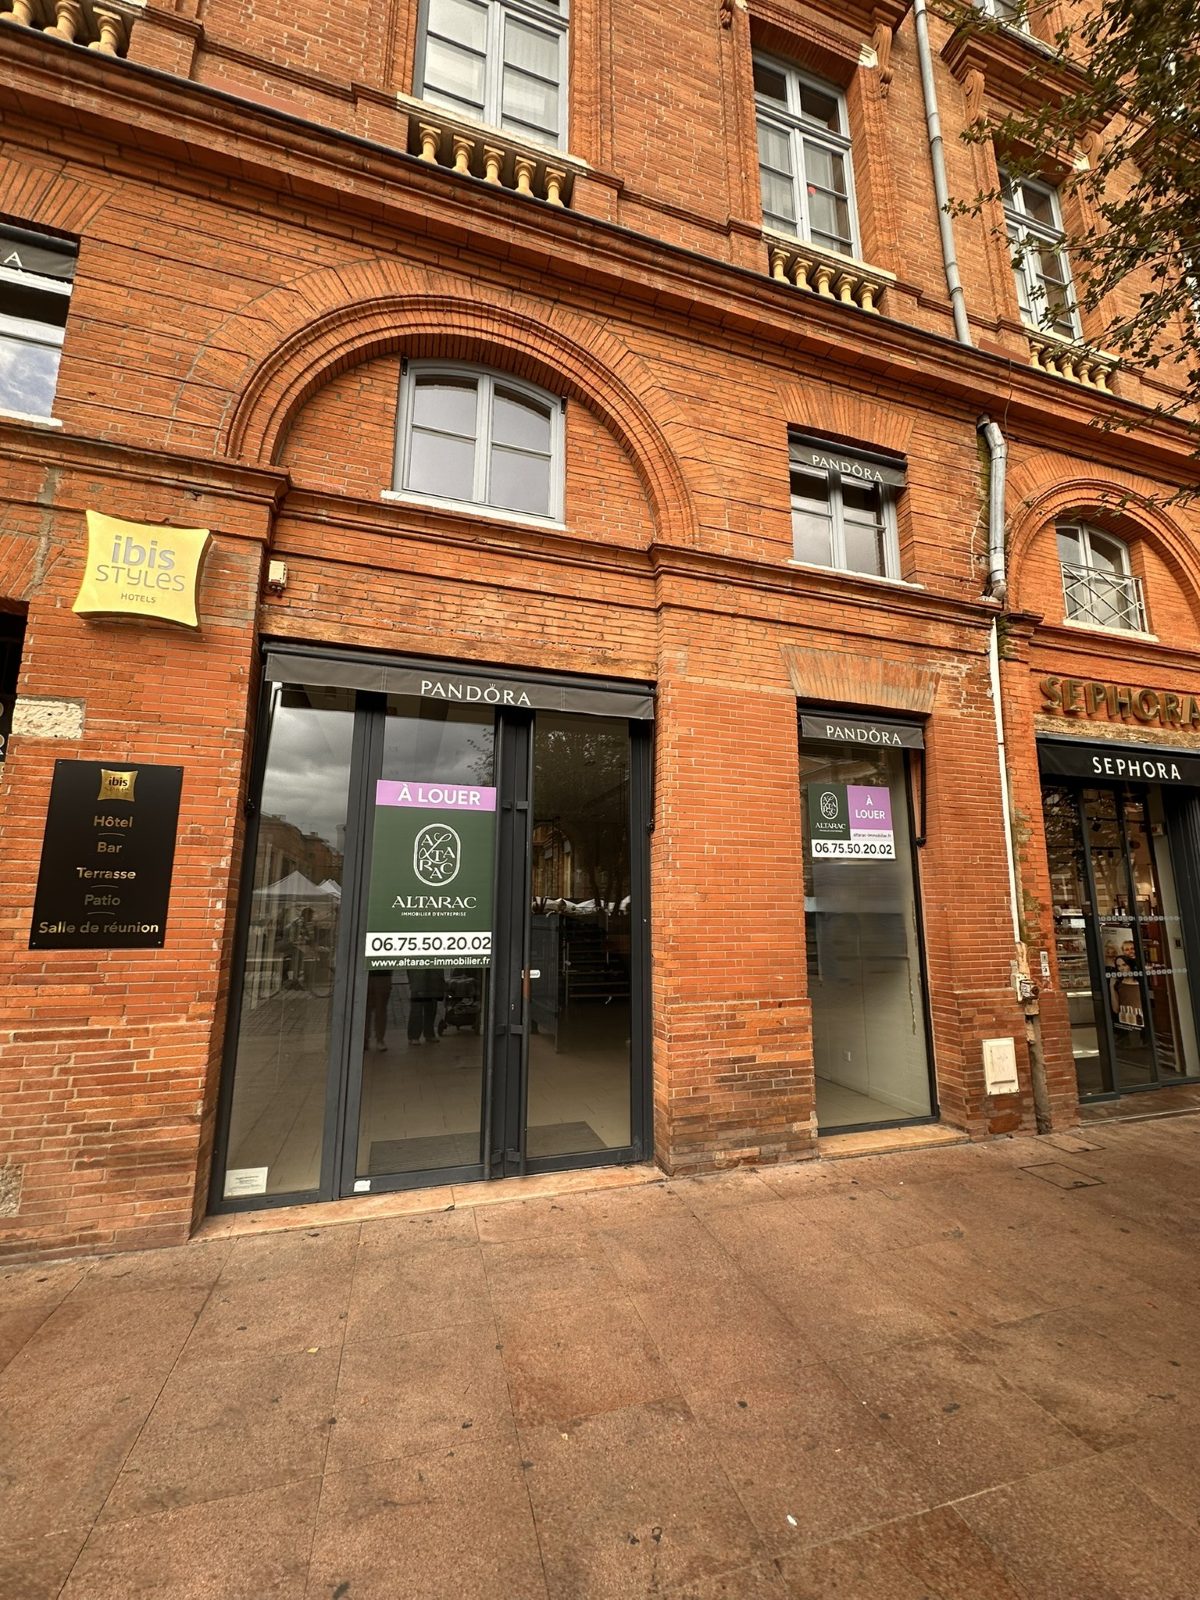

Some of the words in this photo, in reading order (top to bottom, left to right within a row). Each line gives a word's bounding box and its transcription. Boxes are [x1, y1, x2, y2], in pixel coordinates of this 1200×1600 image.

[811, 454, 884, 482] PANDORA
[111, 534, 176, 571] ibis
[120, 592, 157, 604] HOTELS
[420, 680, 532, 706] PANDORA
[826, 725, 902, 745] PANDORA
[1092, 756, 1182, 780] SEPHORA
[108, 776, 128, 787] ibis
[397, 783, 412, 802] À
[418, 788, 481, 806] LOUER
[865, 795, 874, 807] À
[855, 809, 886, 820] LOUER
[93, 815, 133, 828] Hôtel
[815, 822, 847, 830] ALTARAC
[97, 841, 122, 854] Bar
[814, 842, 893, 855] 06.75.50.20.02
[76, 866, 137, 880] Terrasse
[84, 894, 121, 906] Patio
[391, 895, 477, 909] ALTARAC
[38, 921, 76, 934] Salle
[79, 921, 100, 933] de
[103, 920, 160, 933] réunion
[371, 936, 492, 952] 06.75.50.20.02
[371, 956, 491, 968] www.altarac-immobilier.fr
